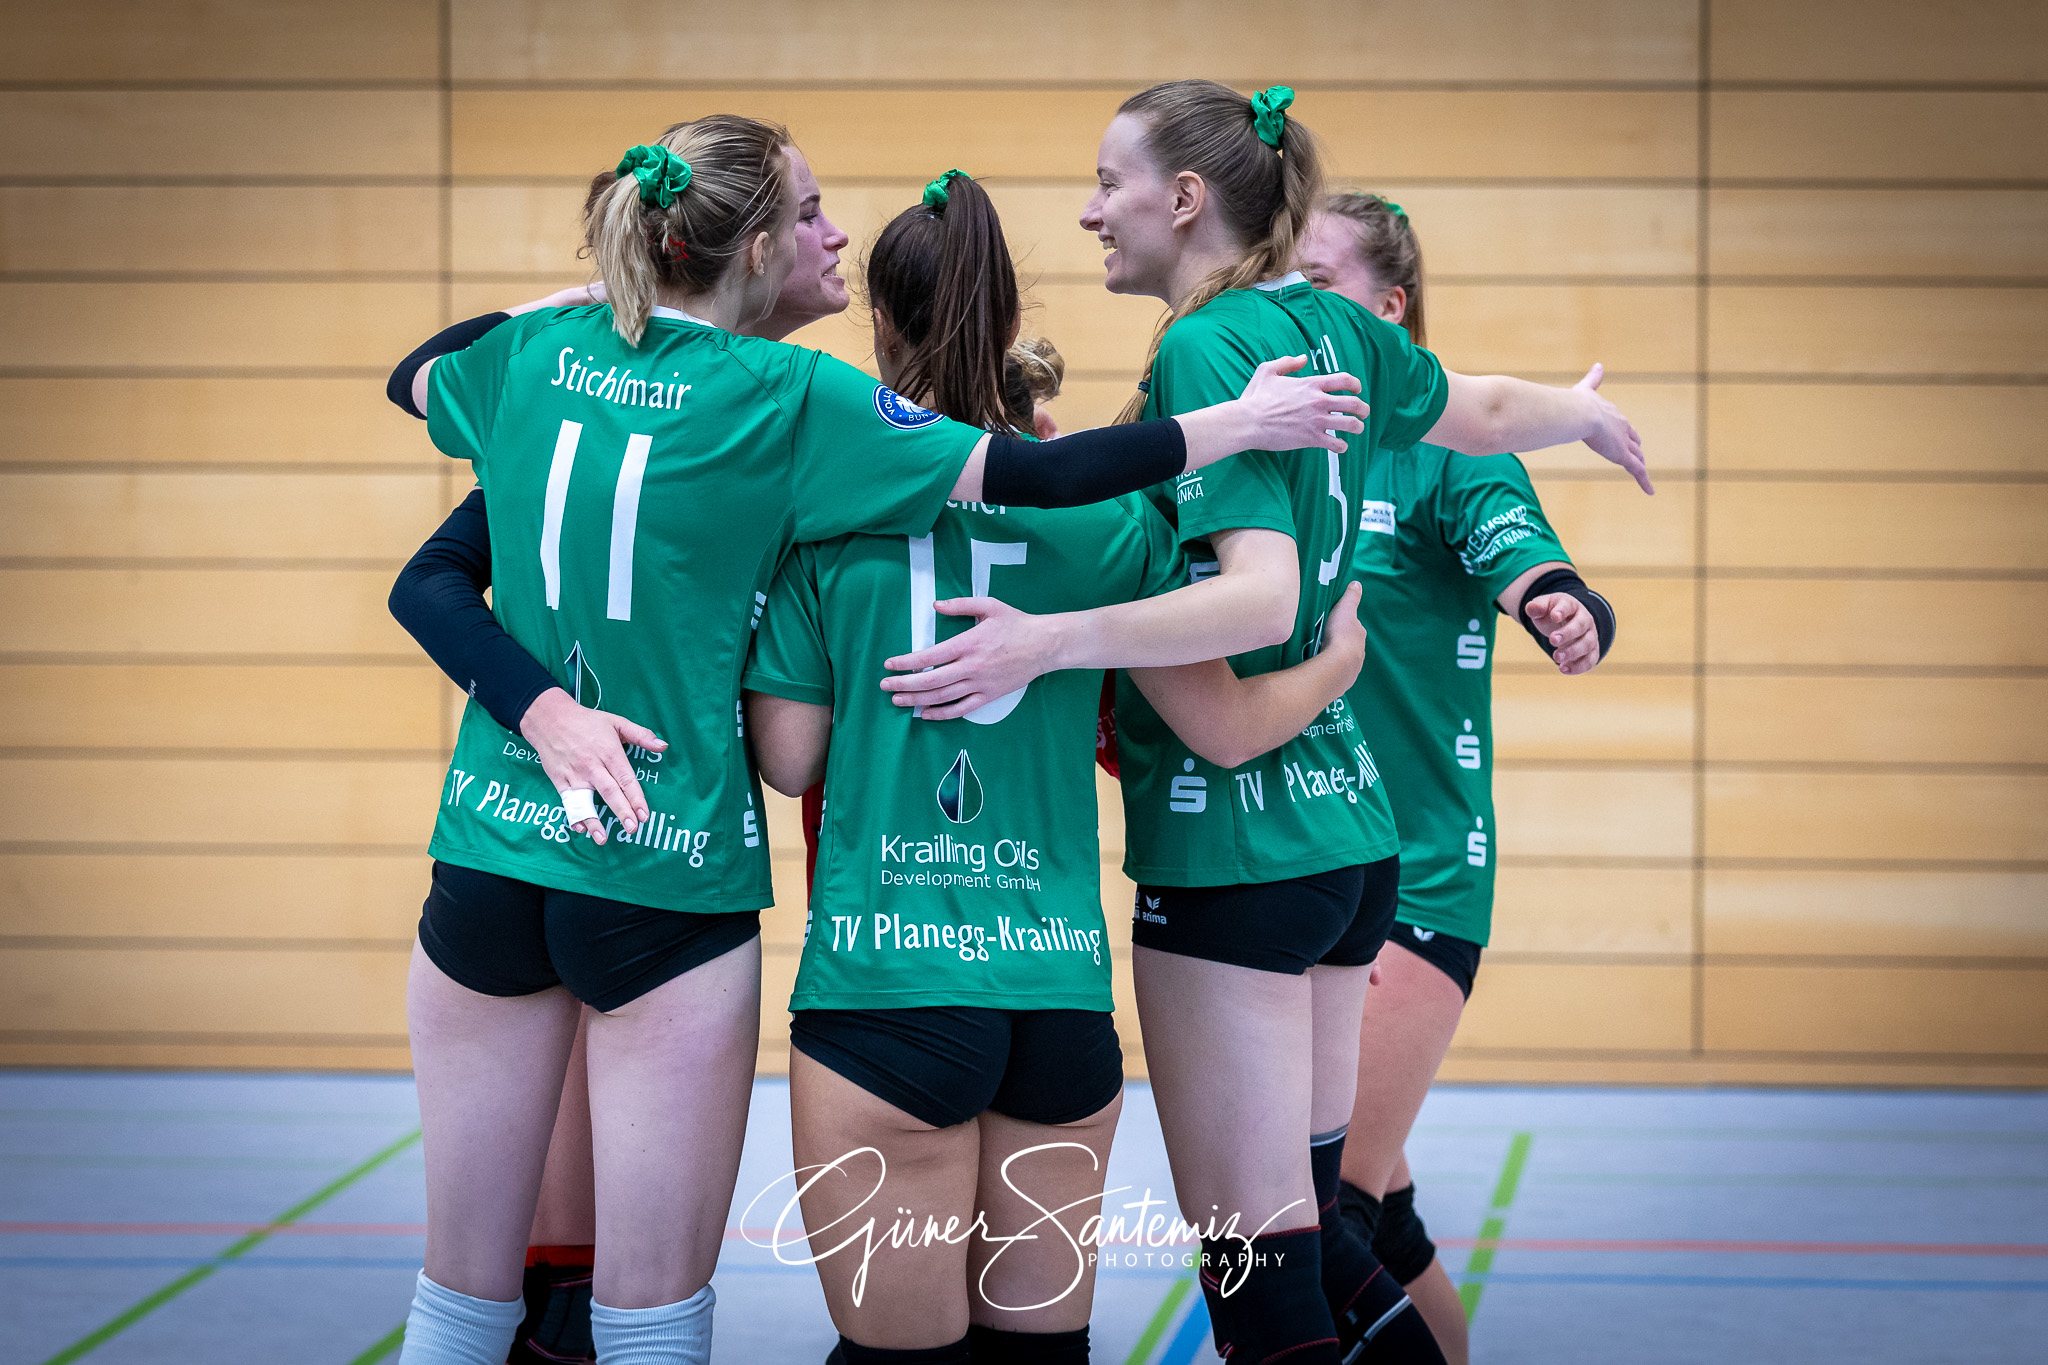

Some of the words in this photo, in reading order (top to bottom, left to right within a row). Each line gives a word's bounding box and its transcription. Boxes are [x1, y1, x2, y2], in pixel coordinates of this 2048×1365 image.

[550, 346, 692, 411] Stichlmair
[539, 418, 654, 622] 11
[447, 769, 475, 807] TV
[1235, 771, 1264, 812] TV
[881, 834, 986, 873] Krailling
[993, 838, 1040, 871] Oils
[881, 869, 991, 889] Development
[996, 874, 1041, 892] GmbH
[1142, 911, 1167, 925] erima
[831, 915, 862, 952] TV
[874, 913, 1101, 966] Planegg-Krailling
